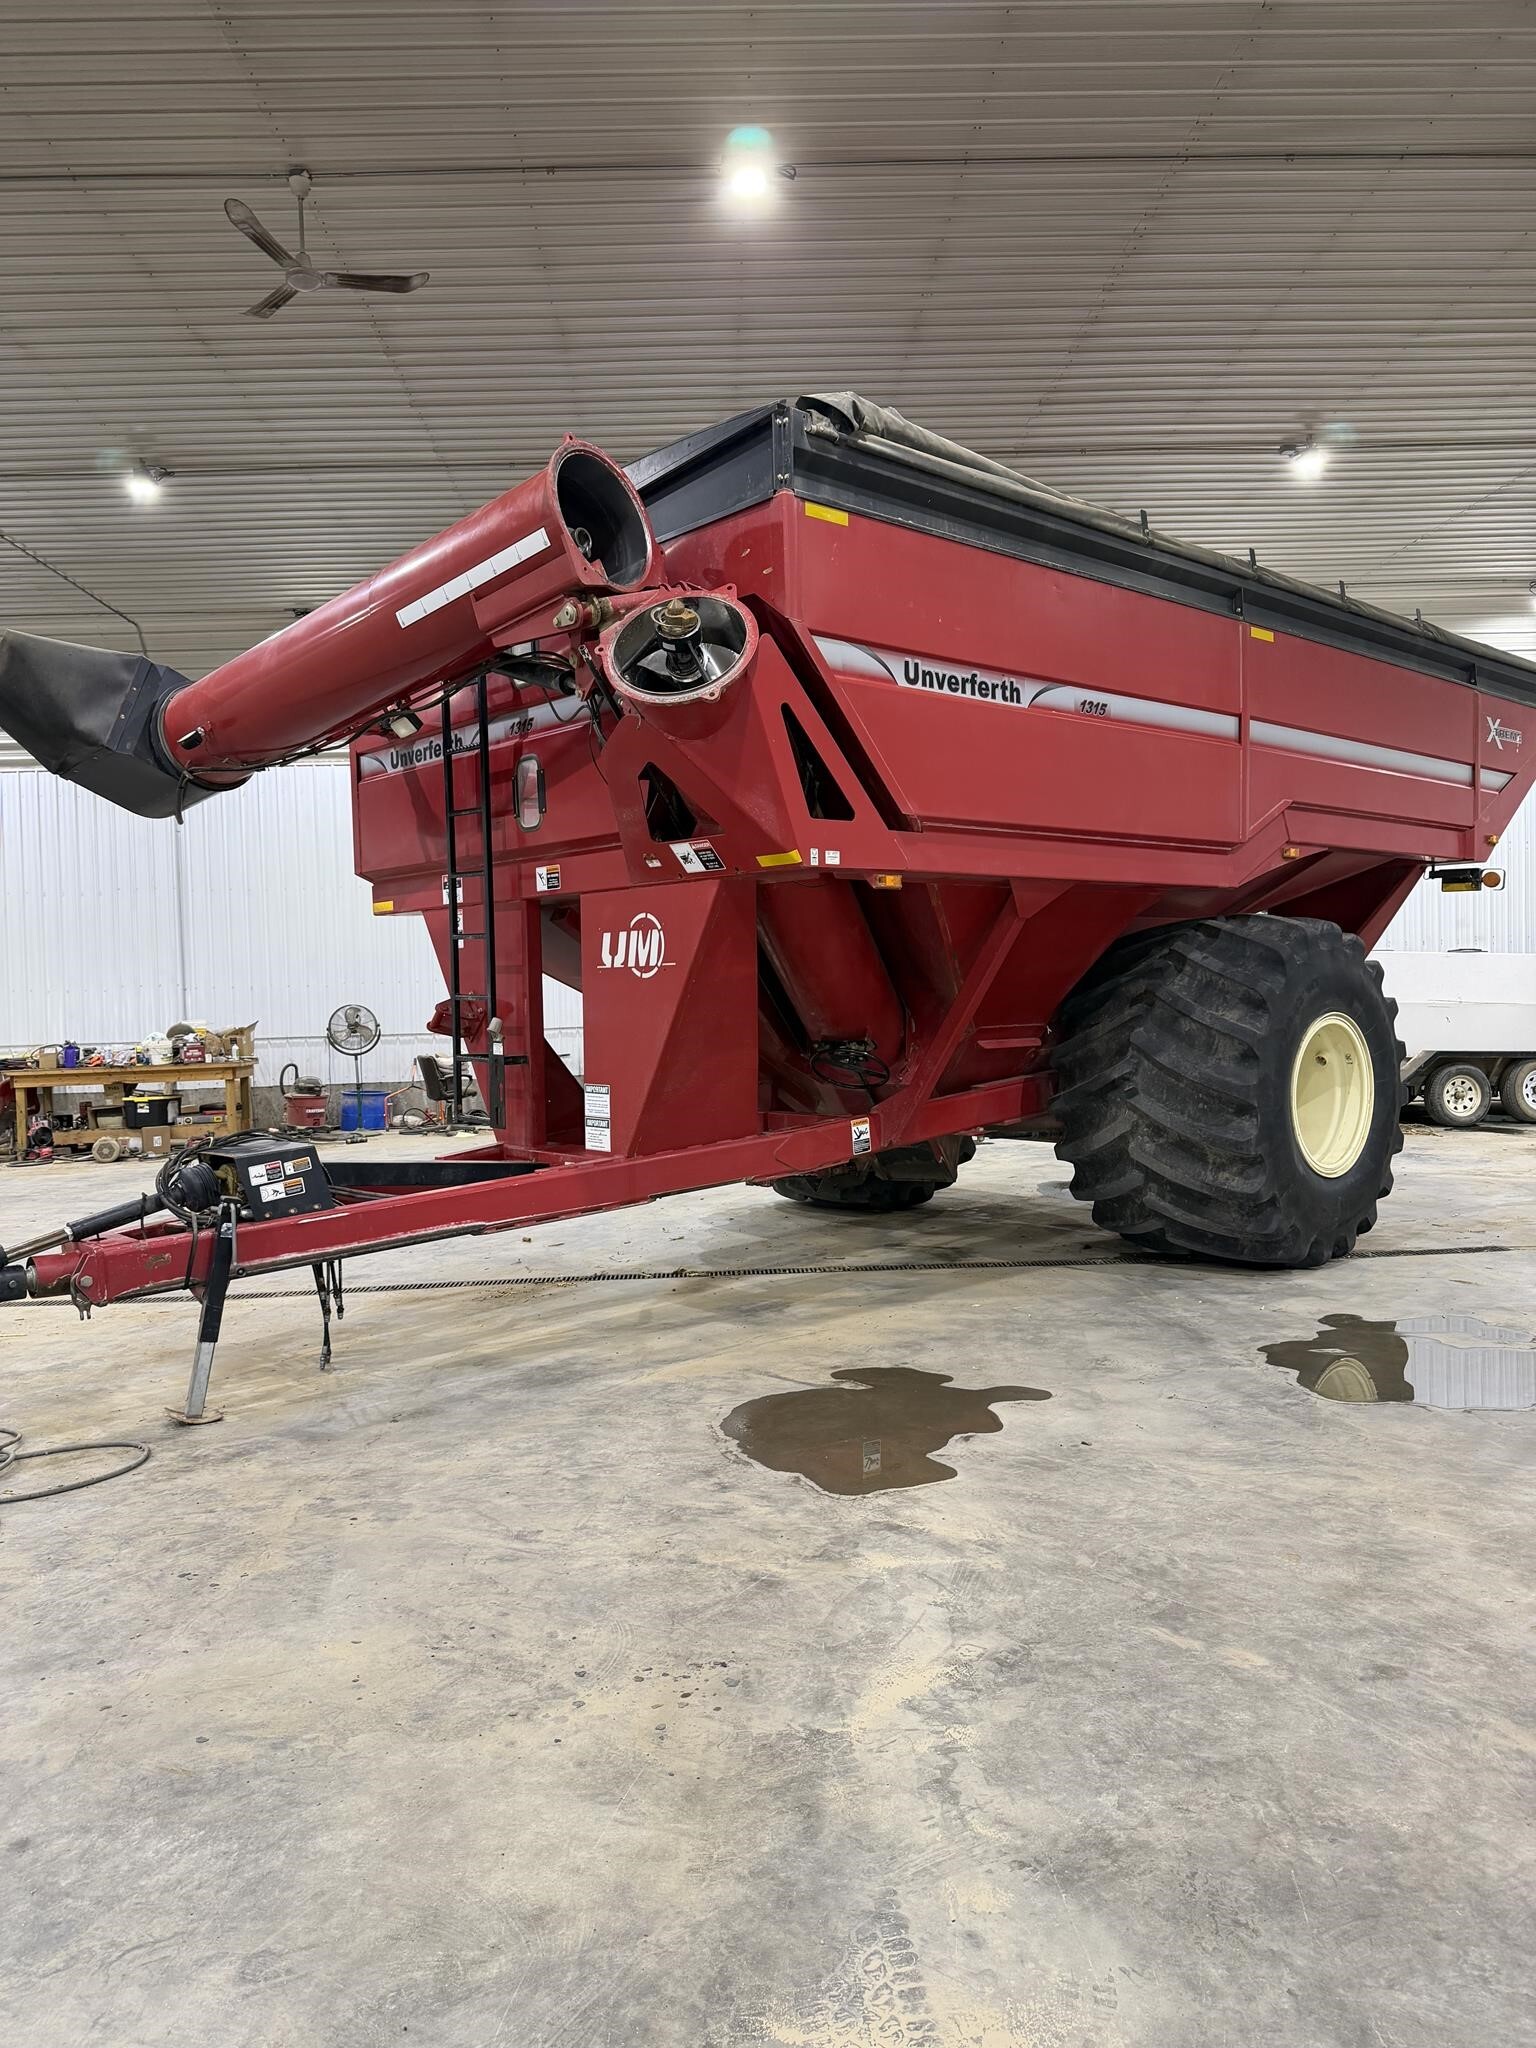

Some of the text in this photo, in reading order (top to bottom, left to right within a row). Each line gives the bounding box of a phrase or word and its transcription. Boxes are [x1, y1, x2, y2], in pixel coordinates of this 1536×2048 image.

[904, 659, 1022, 704] Unverferth
[1079, 699, 1108, 716] 1315
[509, 717, 535, 735] 1315
[586, 1119, 609, 1128] IMPORTANT
